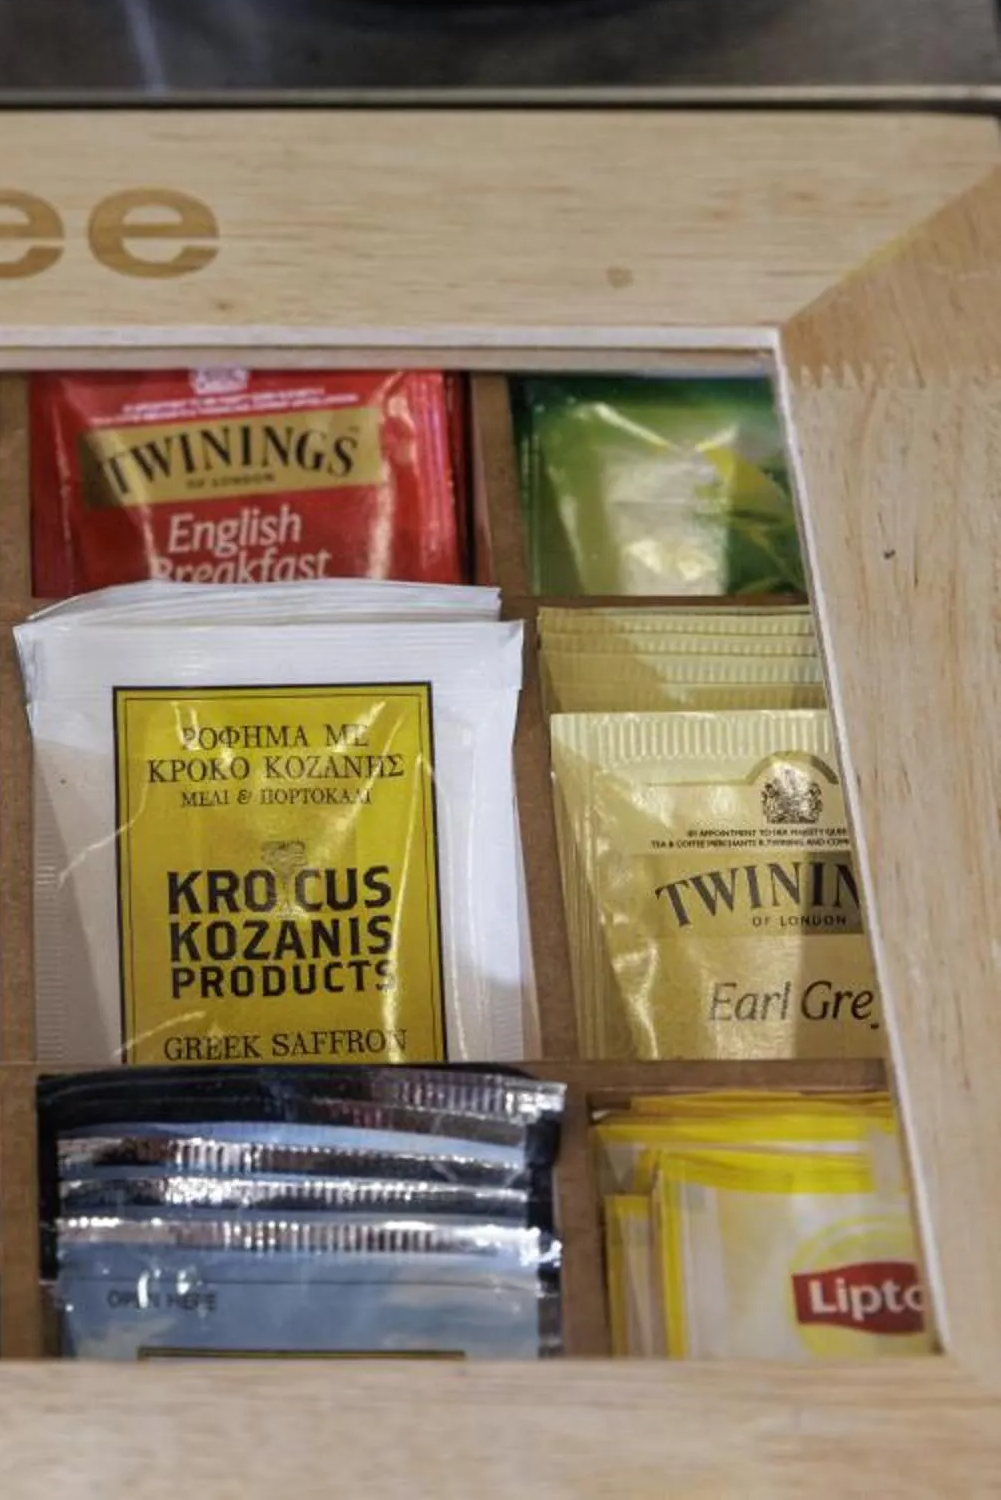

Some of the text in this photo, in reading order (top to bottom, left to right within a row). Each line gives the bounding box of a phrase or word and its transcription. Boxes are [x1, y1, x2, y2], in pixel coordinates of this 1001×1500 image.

[104, 425, 359, 495] TWININGS
[167, 503, 302, 558] English
[150, 548, 333, 584] Breakfast
[169, 915, 394, 963] KOZANIS
[780, 915, 847, 928] LONDON
[171, 959, 397, 999] PRODUCTS
[708, 980, 879, 1029] Earl Gre
[164, 1029, 408, 1062] GREEK SAFFRON
